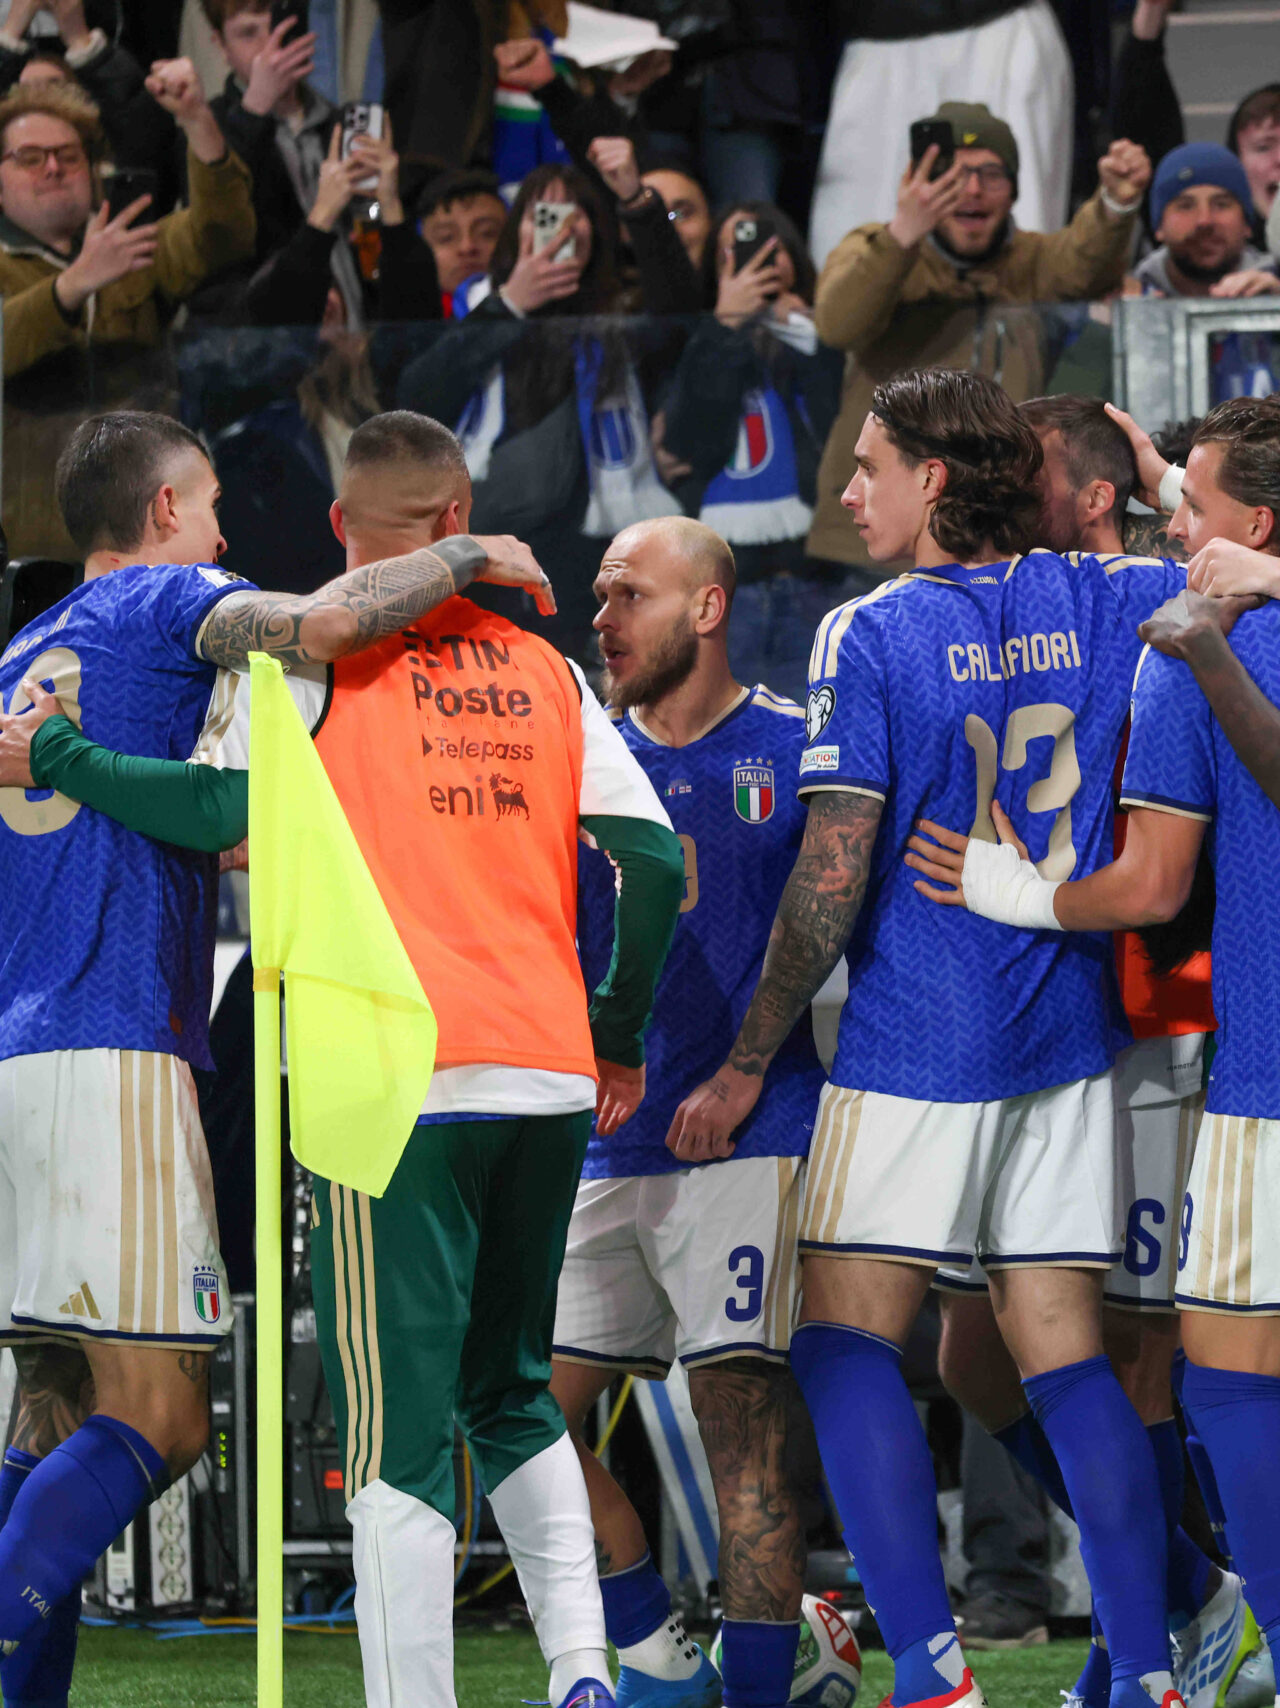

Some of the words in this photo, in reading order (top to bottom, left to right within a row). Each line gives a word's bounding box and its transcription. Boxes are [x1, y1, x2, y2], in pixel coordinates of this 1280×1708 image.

[410, 670, 532, 718] Poste
[435, 736, 534, 763] Telepass
[428, 774, 485, 816] eni
[736, 770, 771, 783] ITALIA
[1123, 1197, 1166, 1277] 6
[195, 1277, 217, 1288] ITALIA
[725, 1244, 764, 1322] 3
